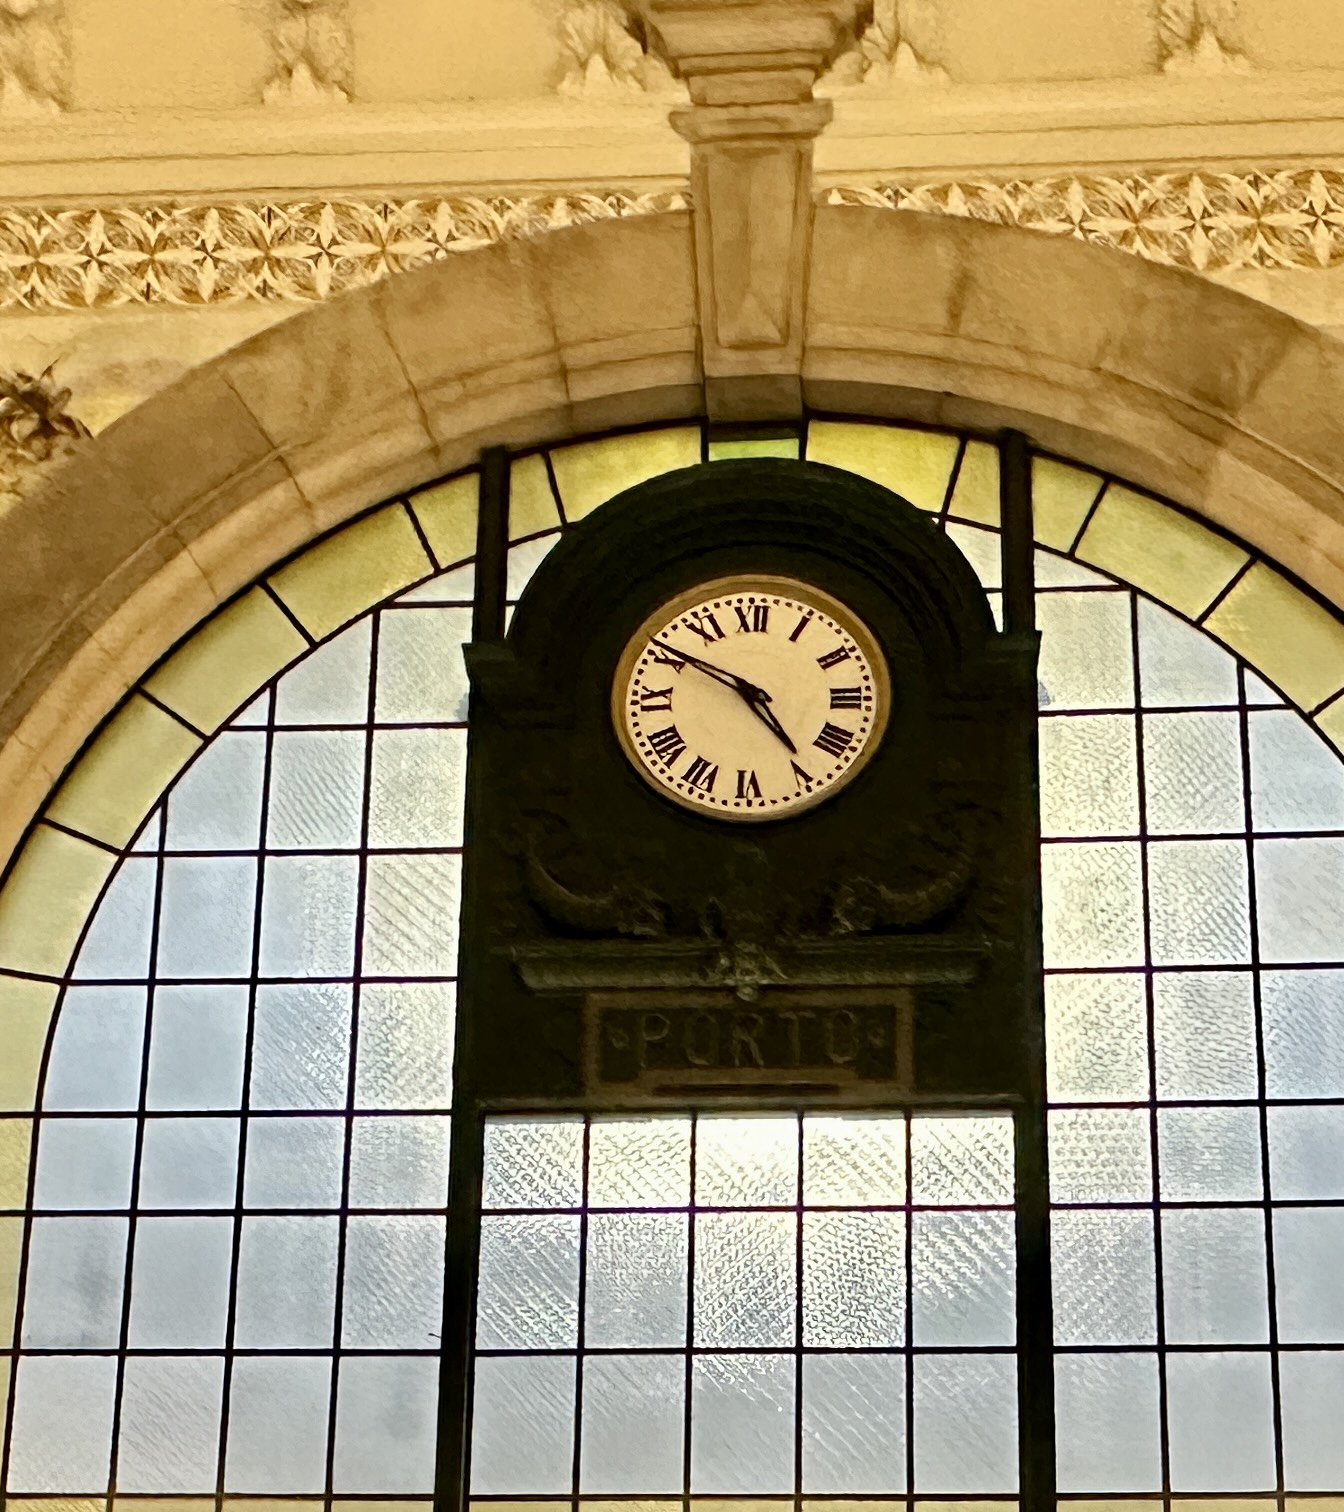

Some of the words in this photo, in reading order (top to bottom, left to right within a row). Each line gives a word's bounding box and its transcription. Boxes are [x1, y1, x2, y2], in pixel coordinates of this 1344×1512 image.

[686, 613, 726, 646] XI
[735, 605, 770, 633] XII
[789, 615, 811, 642] I
[816, 645, 851, 671] II
[641, 686, 674, 711] IX
[830, 686, 862, 710] III
[647, 724, 687, 769] VIII
[681, 755, 719, 793] VII
[736, 770, 762, 798] VI
[790, 759, 813, 789] V
[640, 1010, 859, 1068] PORTO
